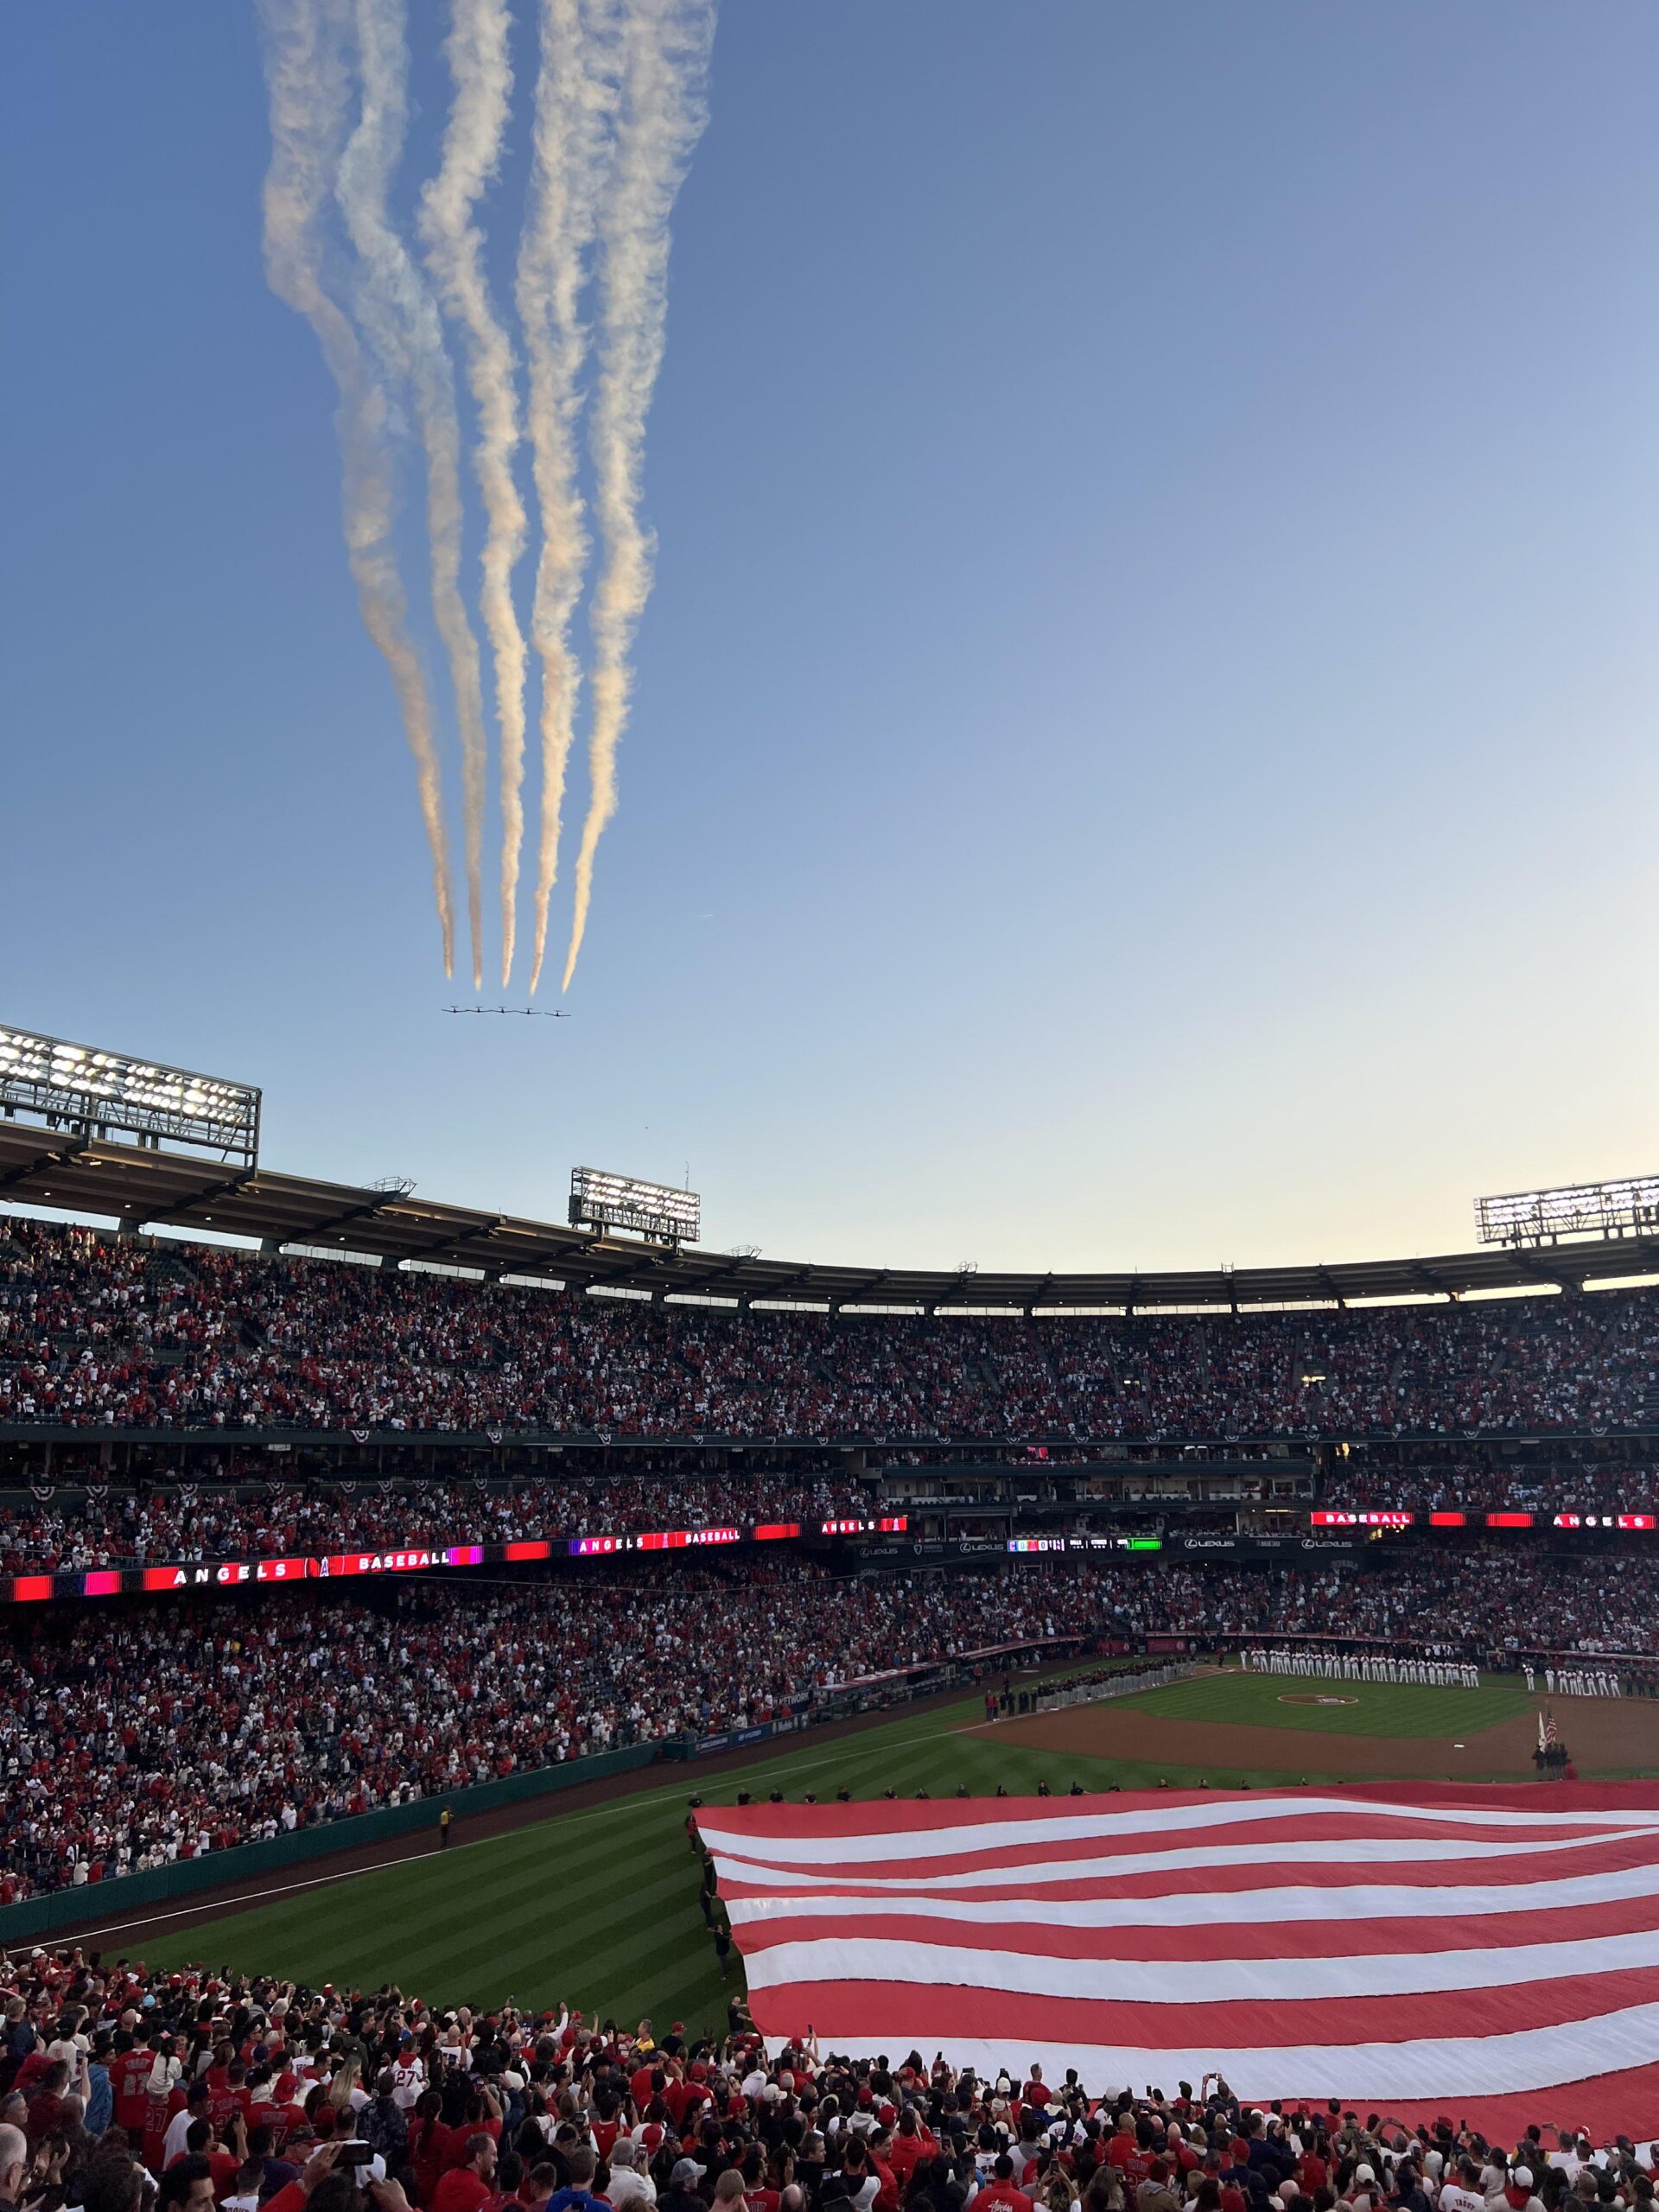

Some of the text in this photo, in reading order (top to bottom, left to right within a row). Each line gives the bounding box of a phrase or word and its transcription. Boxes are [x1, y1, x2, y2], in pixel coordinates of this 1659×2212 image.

[822, 1521, 875, 1533] ANGELS
[1325, 1514, 1410, 1524] BASEBALL
[1554, 1516, 1644, 1528] ANGELS
[579, 1536, 644, 1553] ANGELS
[684, 1529, 741, 1544] BASEBALL
[174, 1562, 287, 1584] ANGELS
[359, 1551, 450, 1571] BASEBALL
[123, 2071, 150, 2096] 27
[397, 2069, 416, 2088] 27
[145, 2106, 168, 2133] 27
[1454, 2199, 1476, 2211] TROUT
